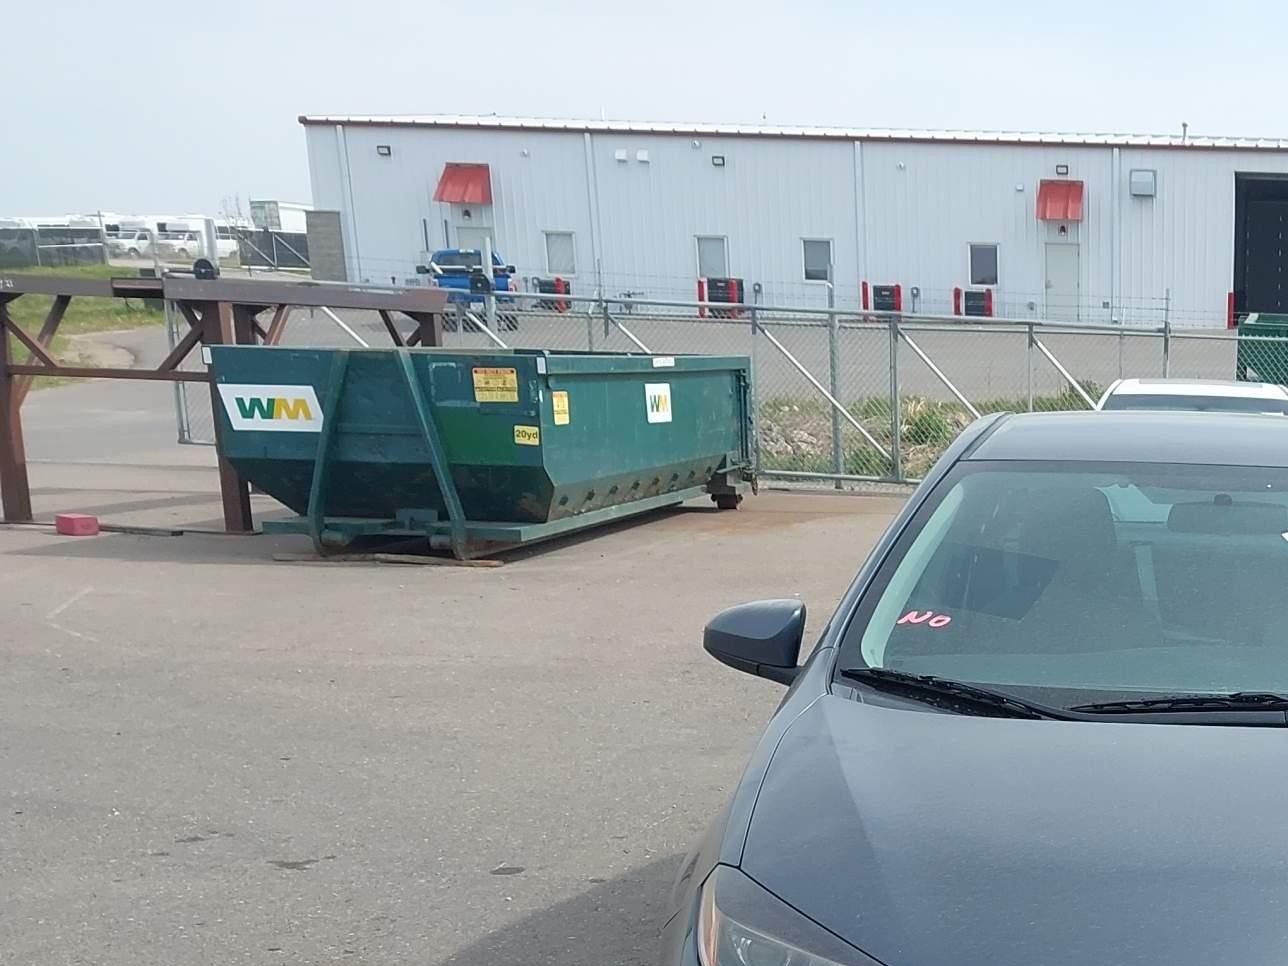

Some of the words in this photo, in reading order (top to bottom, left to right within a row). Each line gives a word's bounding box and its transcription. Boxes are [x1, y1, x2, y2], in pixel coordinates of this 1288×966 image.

[235, 397, 312, 420] WM
[516, 429, 537, 441] 20yd
[896, 610, 952, 628] NO
